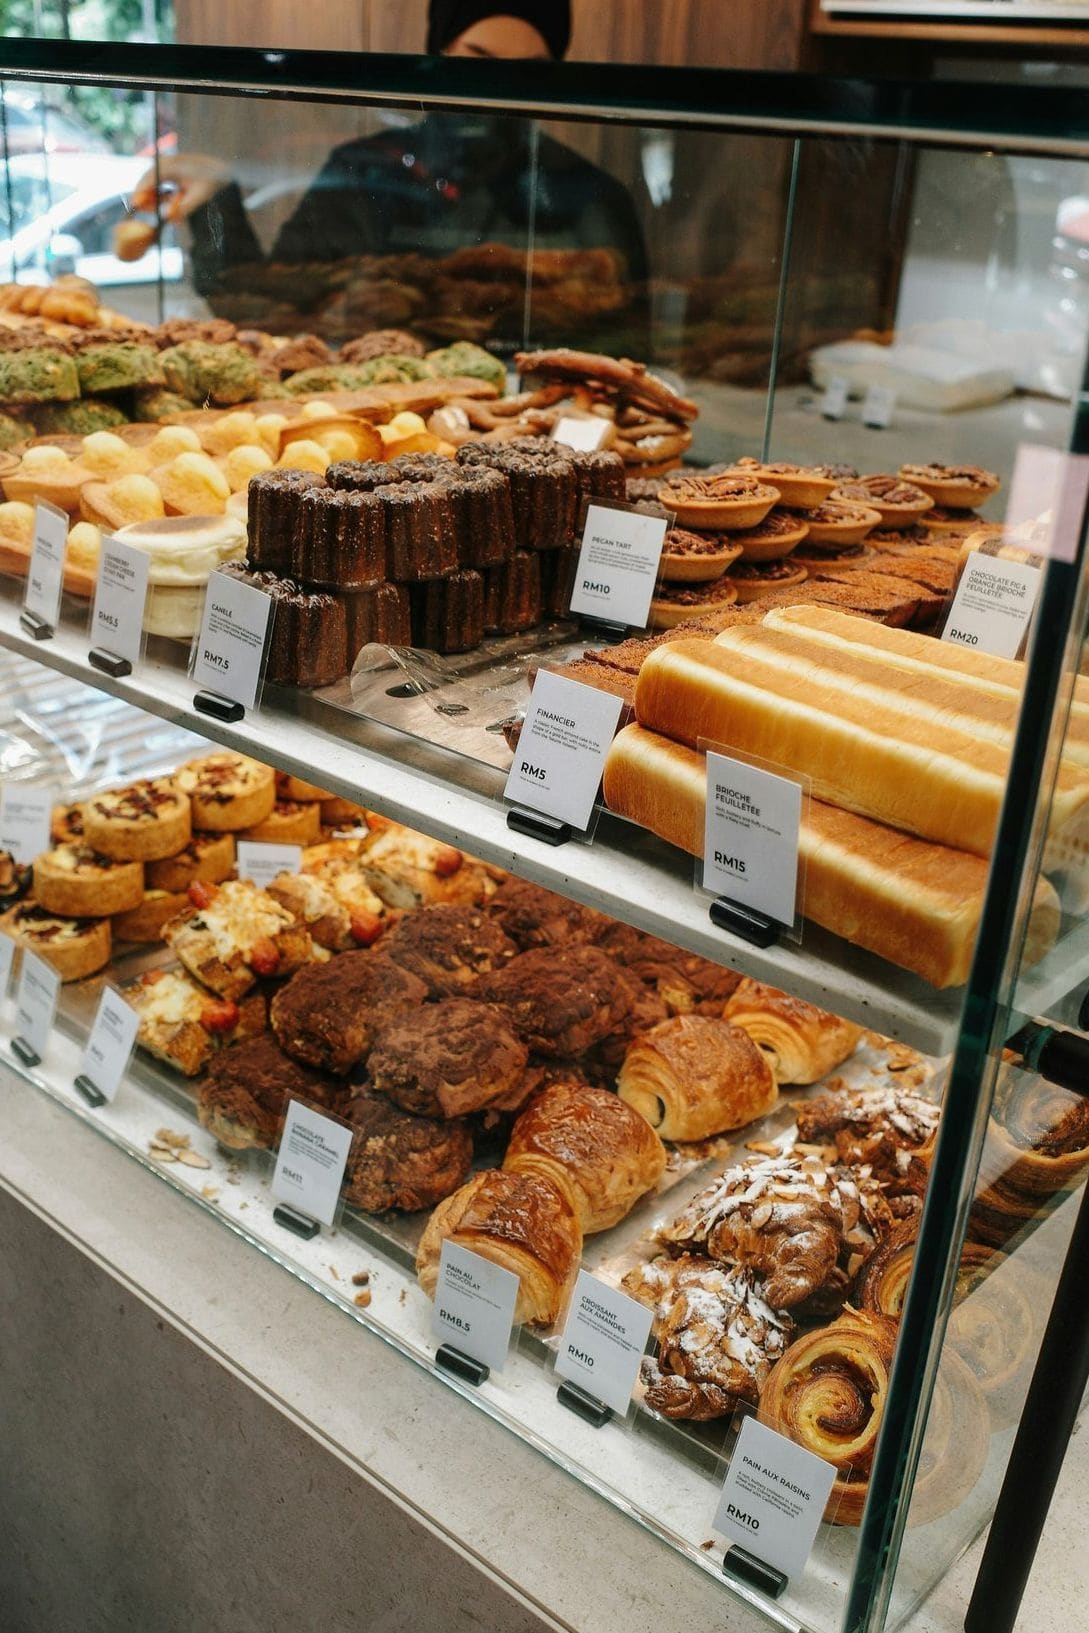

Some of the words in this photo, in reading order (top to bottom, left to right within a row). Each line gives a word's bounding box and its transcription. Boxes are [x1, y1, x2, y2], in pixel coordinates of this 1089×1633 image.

[592, 536, 614, 546] PECAN
[615, 541, 632, 550] TART
[583, 581, 610, 594] RM10
[968, 576, 994, 589] ORANGE
[996, 584, 1025, 598] BRIOCHE
[970, 569, 1009, 585] CHOCOLATE
[1009, 581, 1022, 589] FIG
[950, 629, 979, 645] RM20
[204, 650, 229, 670] RM7.5
[536, 708, 576, 729] FINANCIER
[521, 761, 547, 781] RM5
[716, 784, 751, 804] BRIOCHE
[714, 850, 745, 874] RM15
[446, 1269, 480, 1291] CHOCOLAT
[447, 1263, 462, 1275] PAIN
[463, 1272, 472, 1281] AU
[580, 1302, 593, 1314] AUX
[595, 1311, 626, 1334] AMANDES
[582, 1295, 617, 1321] CROISSANT
[440, 1309, 471, 1332] RM8.5
[568, 1344, 594, 1368] RM10
[742, 1455, 762, 1472] PAIN
[762, 1467, 779, 1482] AUX
[780, 1478, 811, 1501] RAISINS
[727, 1503, 760, 1531] RM10
